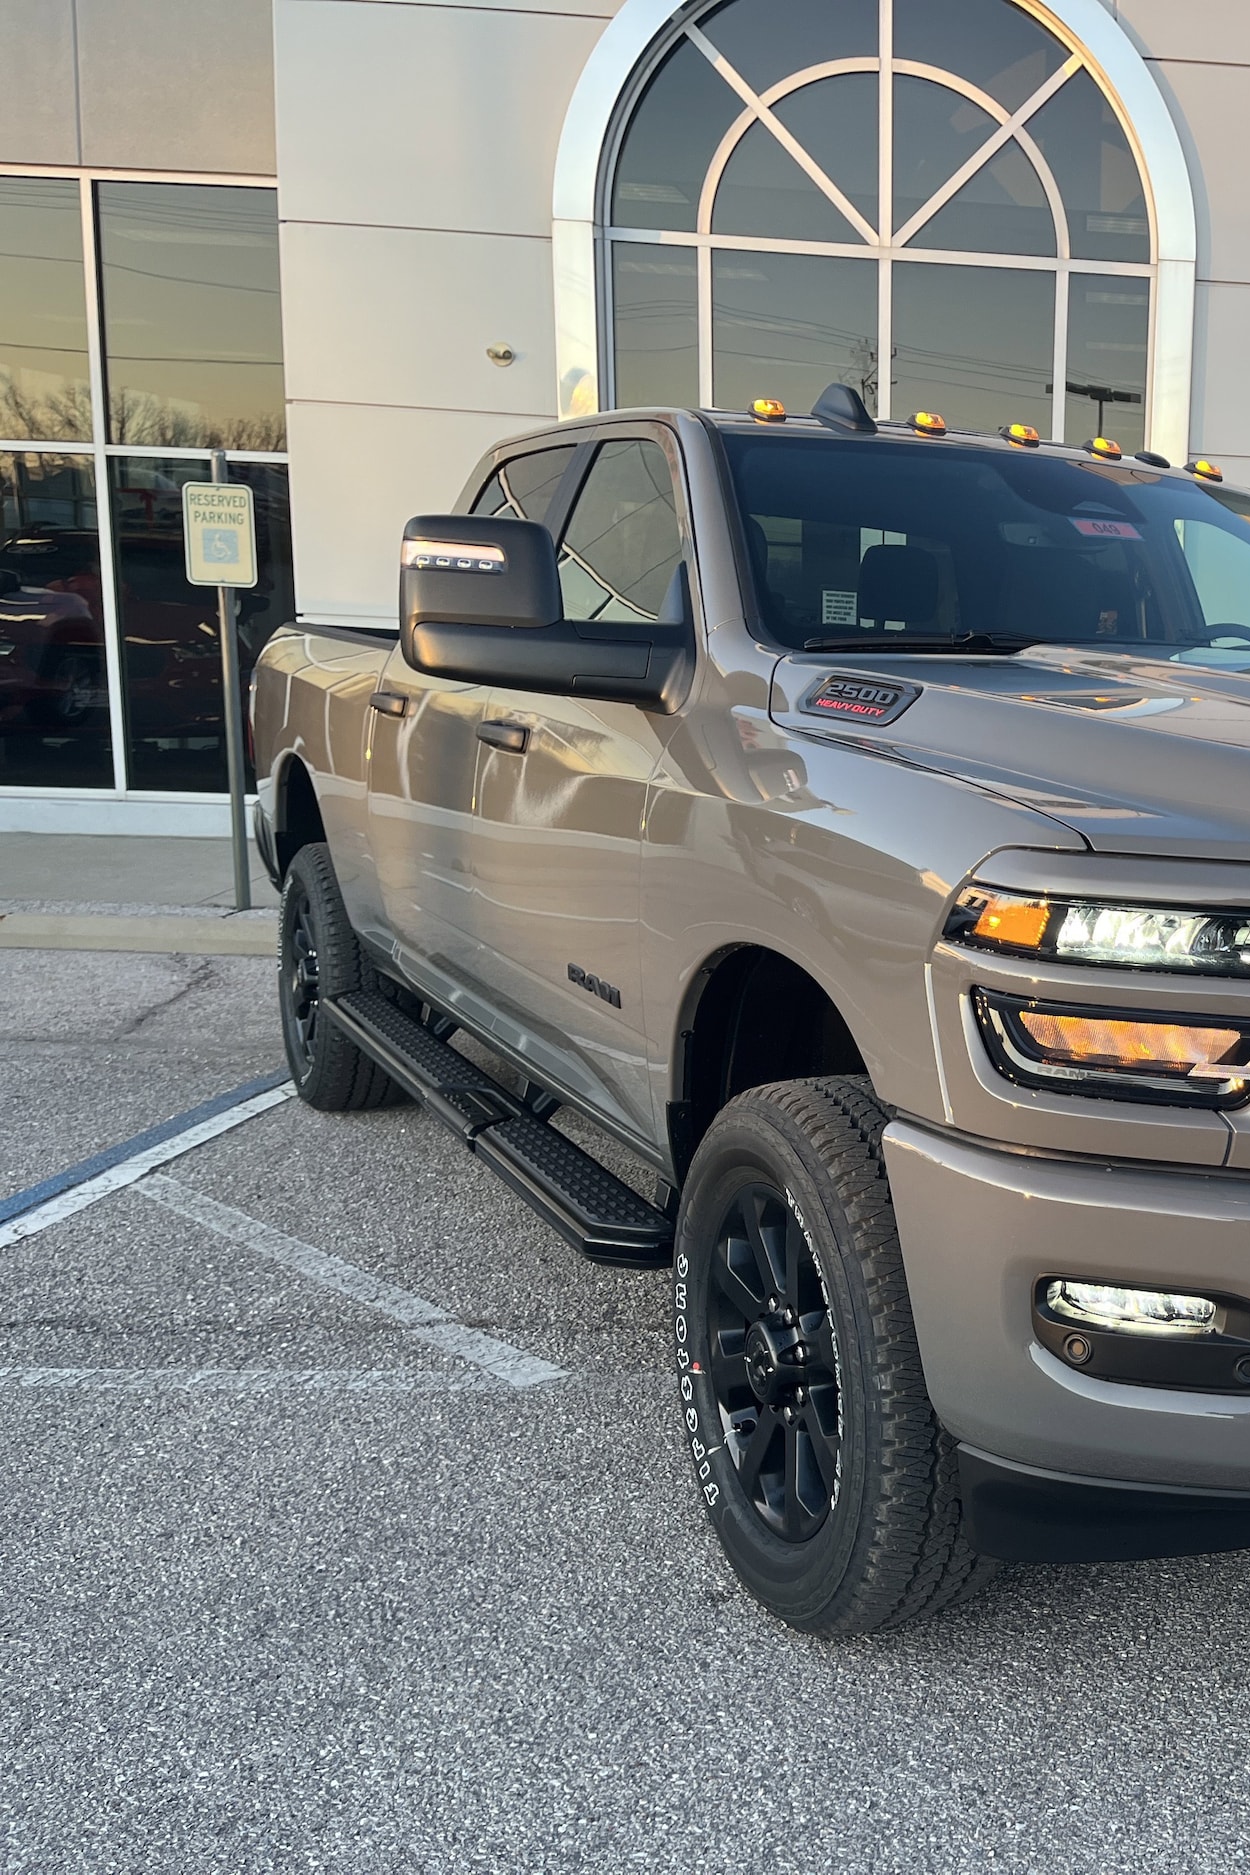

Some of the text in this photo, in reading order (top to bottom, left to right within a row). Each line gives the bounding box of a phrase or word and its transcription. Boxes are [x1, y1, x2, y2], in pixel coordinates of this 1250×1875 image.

[189, 493, 247, 508] RESERVED
[194, 511, 245, 525] PARKING
[826, 683, 895, 704] 2500
[816, 698, 885, 717] HEAVY DUTY
[567, 962, 622, 1009] RAM
[1036, 1066, 1086, 1078] RAM
